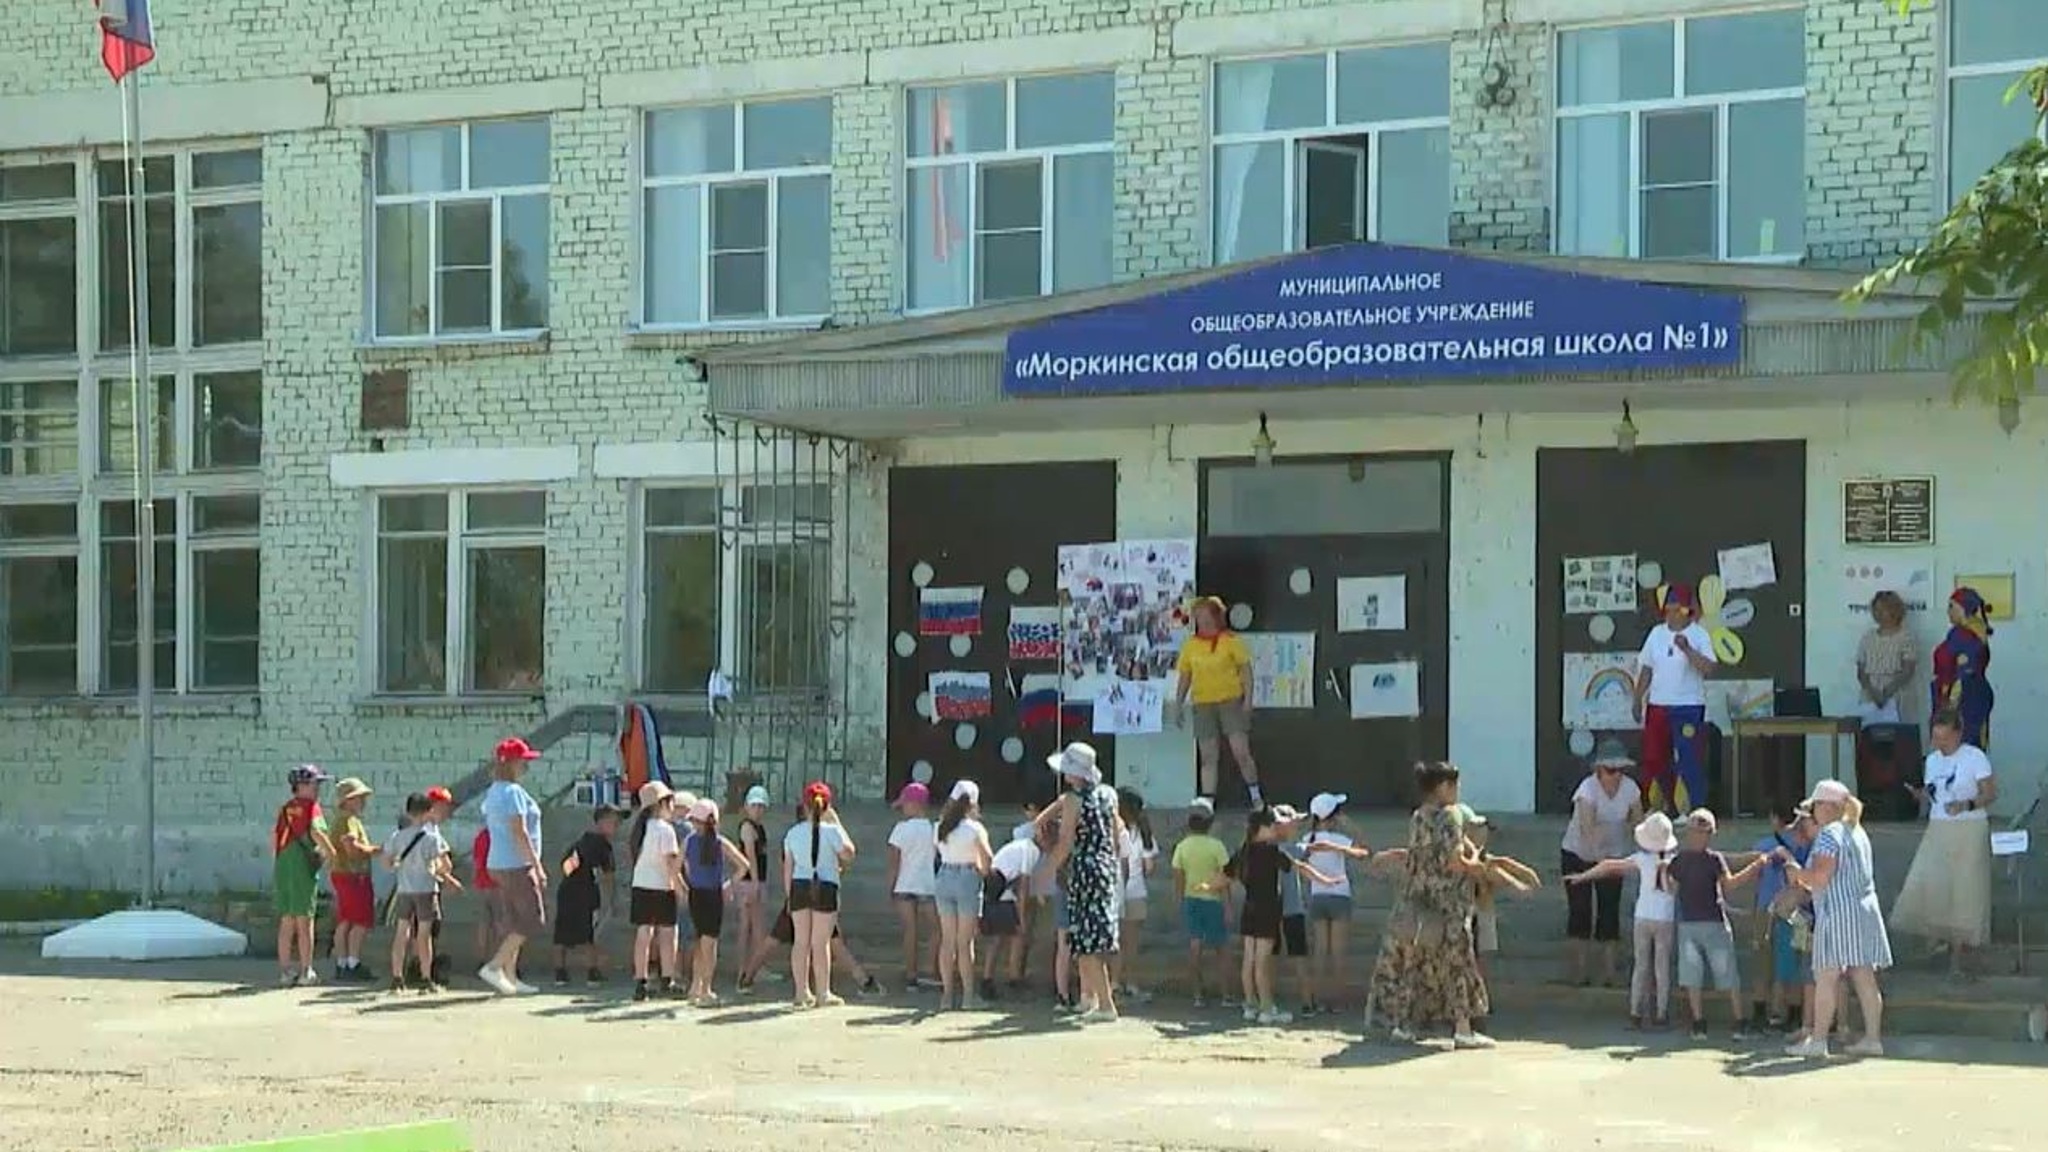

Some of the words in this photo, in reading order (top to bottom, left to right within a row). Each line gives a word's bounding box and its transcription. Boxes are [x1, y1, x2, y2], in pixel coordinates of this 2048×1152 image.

[1279, 272, 1442, 297] МУНИЦИПАЛЬНОЕ
[1190, 308, 1411, 334] ОБЩЕОБРАЗОВАТЕЛЬНОЕ
[1415, 300, 1534, 324] УЧРЕЖДЕНИЕ
[1015, 351, 1199, 381] «Моркинская
[1206, 336, 1545, 371] общеобразовательная
[1554, 331, 1654, 356] школа
[1663, 321, 1729, 352] №1»
